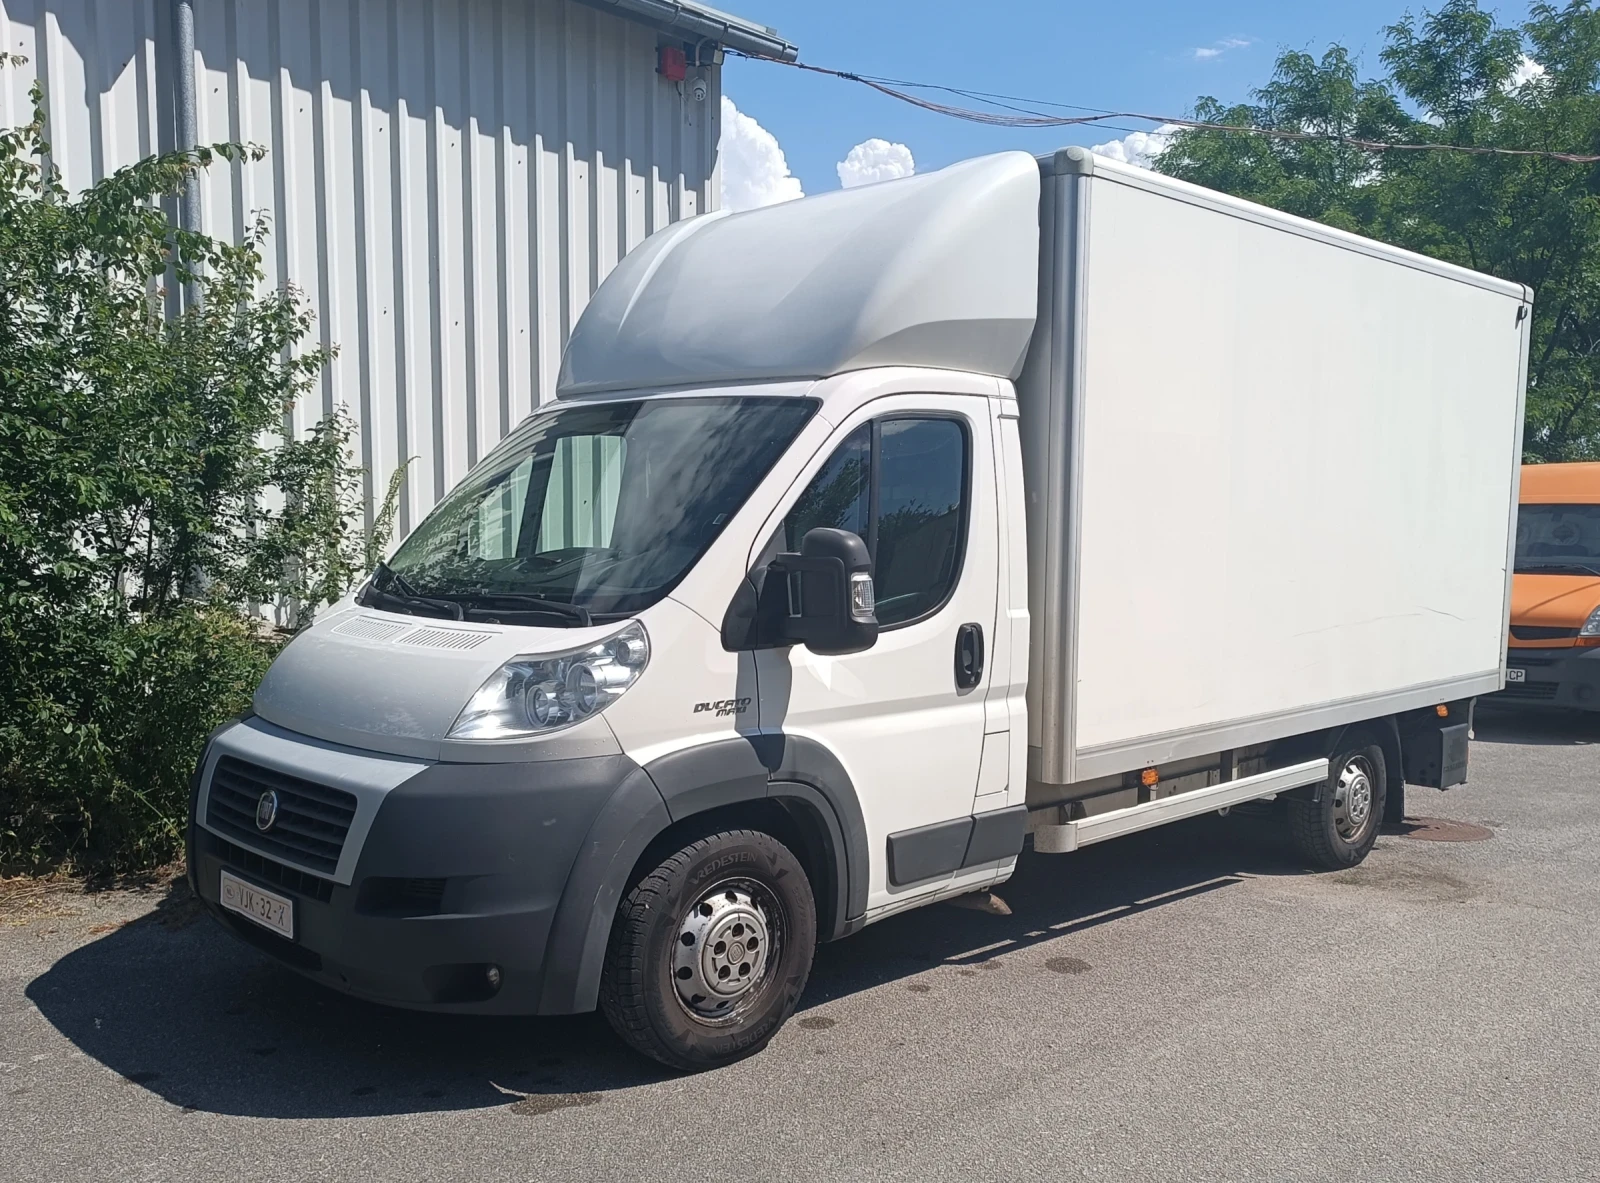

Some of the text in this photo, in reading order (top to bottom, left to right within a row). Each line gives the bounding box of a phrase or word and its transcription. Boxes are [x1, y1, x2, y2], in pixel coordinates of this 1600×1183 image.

[1510, 670, 1523, 680] CP
[693, 697, 751, 713] DUCATO
[689, 851, 758, 885] VREDESTEIN
[712, 1017, 777, 1055] VREDESTEIN
